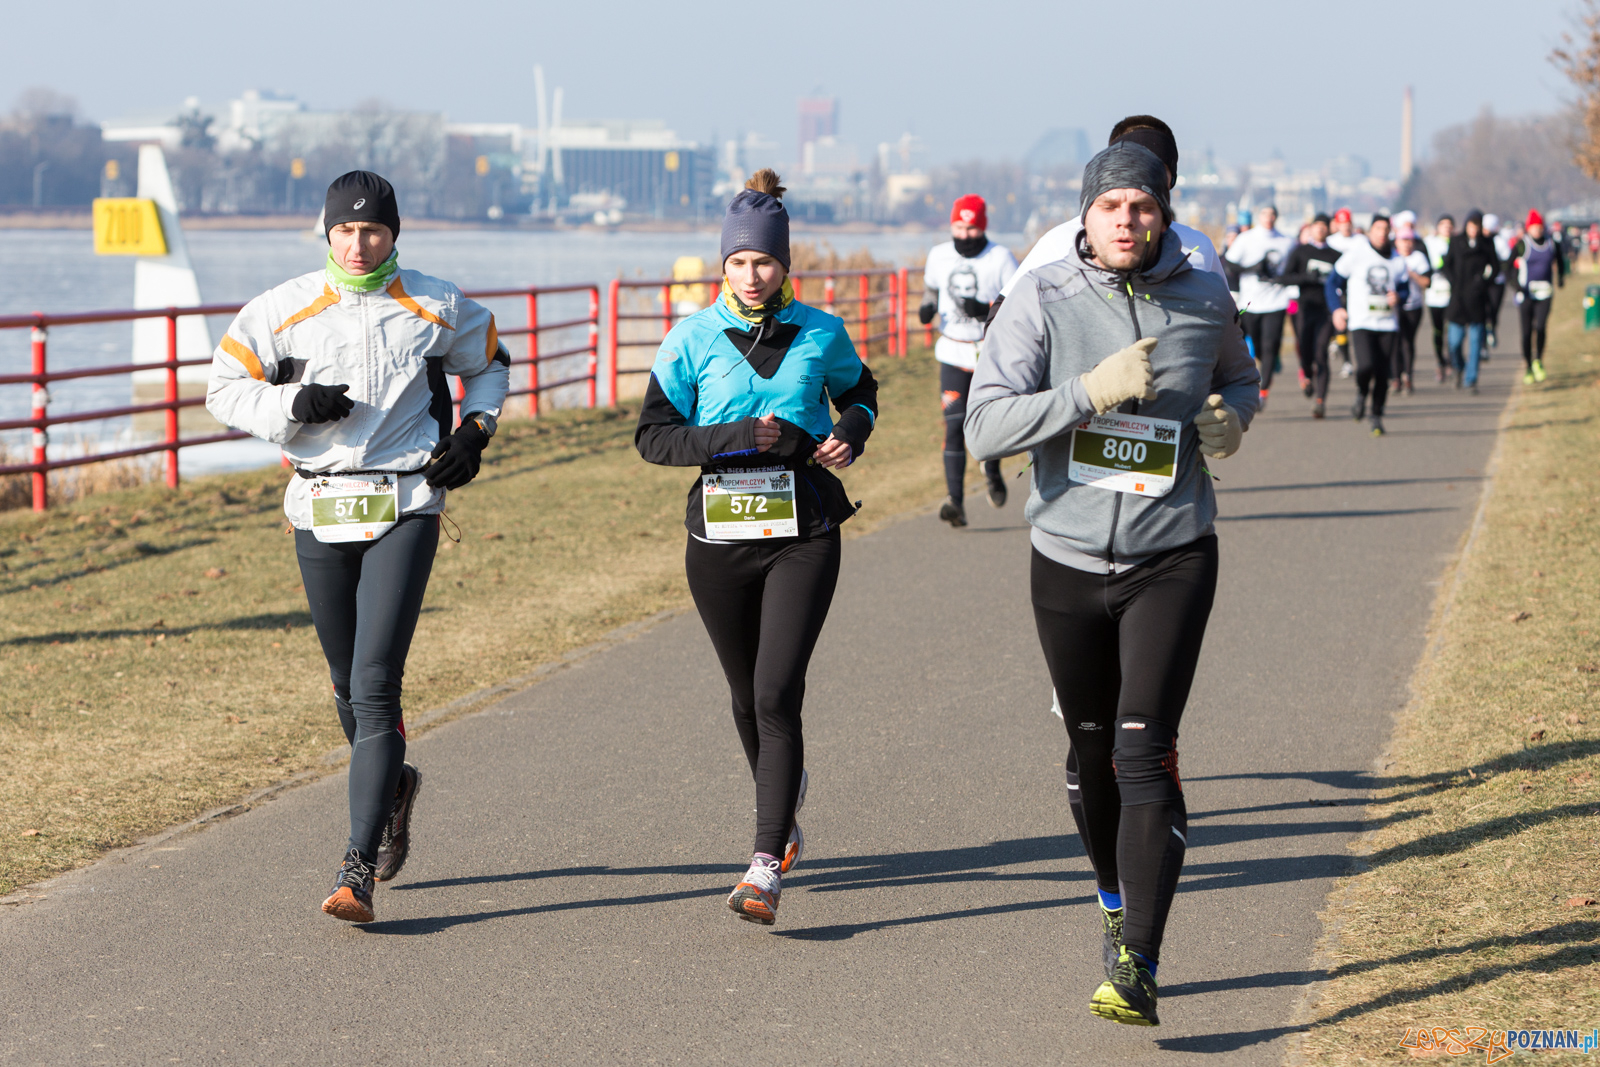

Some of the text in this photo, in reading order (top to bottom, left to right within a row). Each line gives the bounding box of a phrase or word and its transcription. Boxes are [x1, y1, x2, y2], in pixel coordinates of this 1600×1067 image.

[104, 204, 143, 246] 200
[1102, 437, 1148, 464] 800
[334, 497, 368, 517] 571
[730, 494, 768, 514] 572
